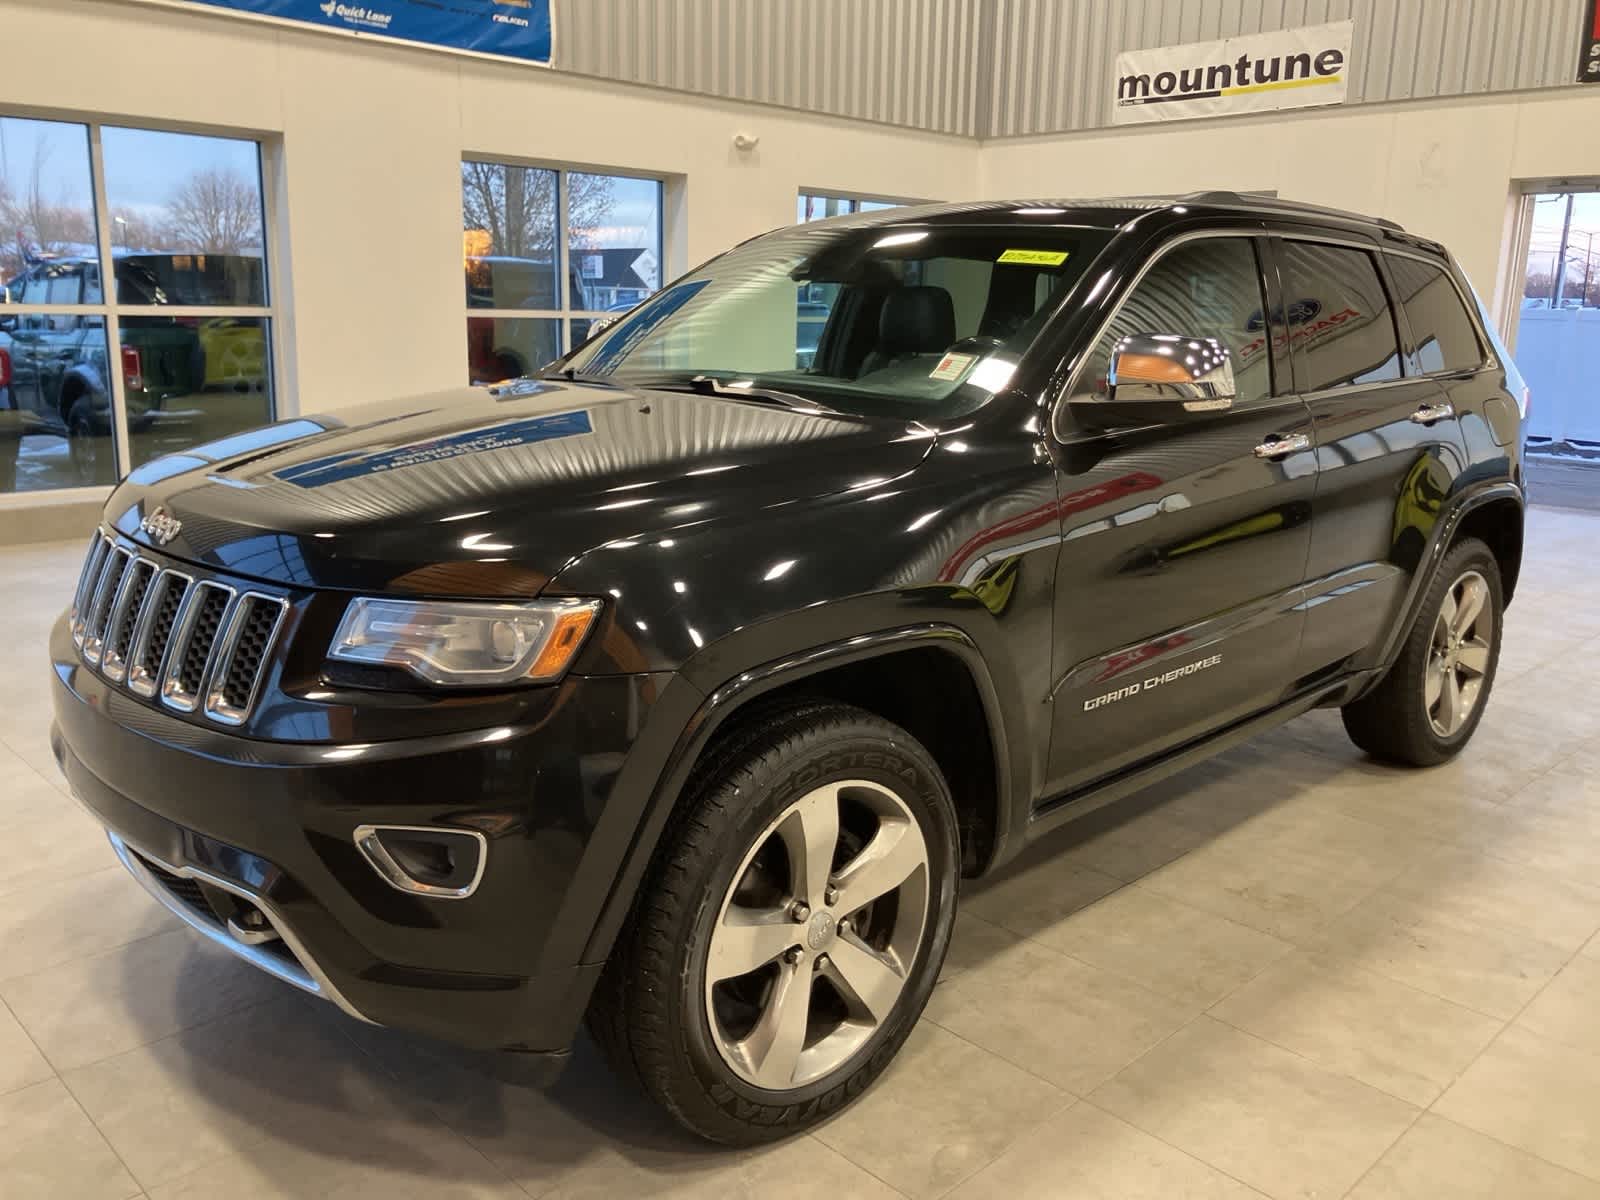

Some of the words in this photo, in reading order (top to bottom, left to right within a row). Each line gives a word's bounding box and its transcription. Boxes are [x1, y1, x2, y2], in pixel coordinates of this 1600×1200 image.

[336, 4, 364, 18] Quick
[366, 9, 392, 23] Lane
[1117, 49, 1344, 99] mountune
[1083, 683, 1141, 712] GRAND
[1143, 653, 1222, 690] CHEROKEE
